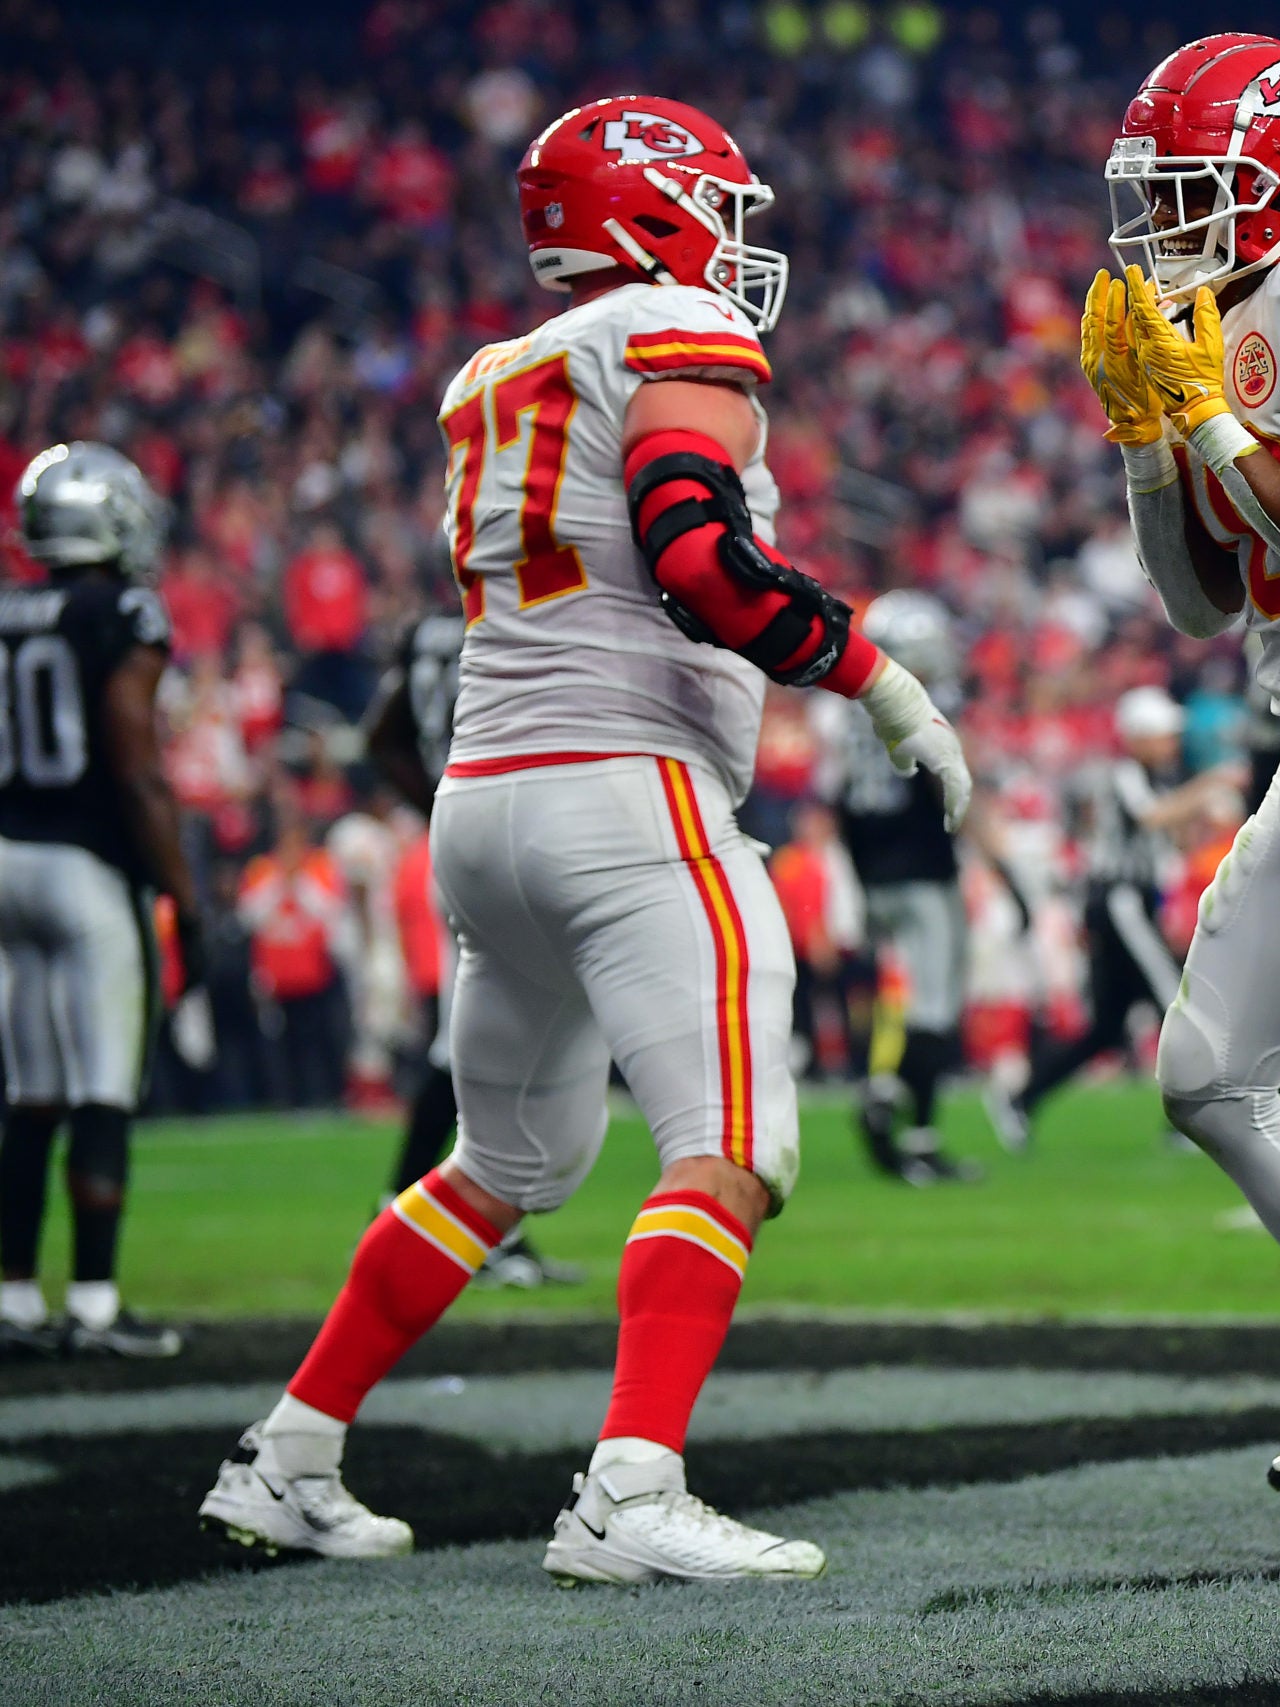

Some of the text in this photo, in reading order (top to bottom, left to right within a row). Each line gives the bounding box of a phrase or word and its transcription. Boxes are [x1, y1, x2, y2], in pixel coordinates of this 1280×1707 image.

[624, 120, 688, 154] KC
[439, 350, 588, 632] 77
[0, 633, 87, 788] 0
